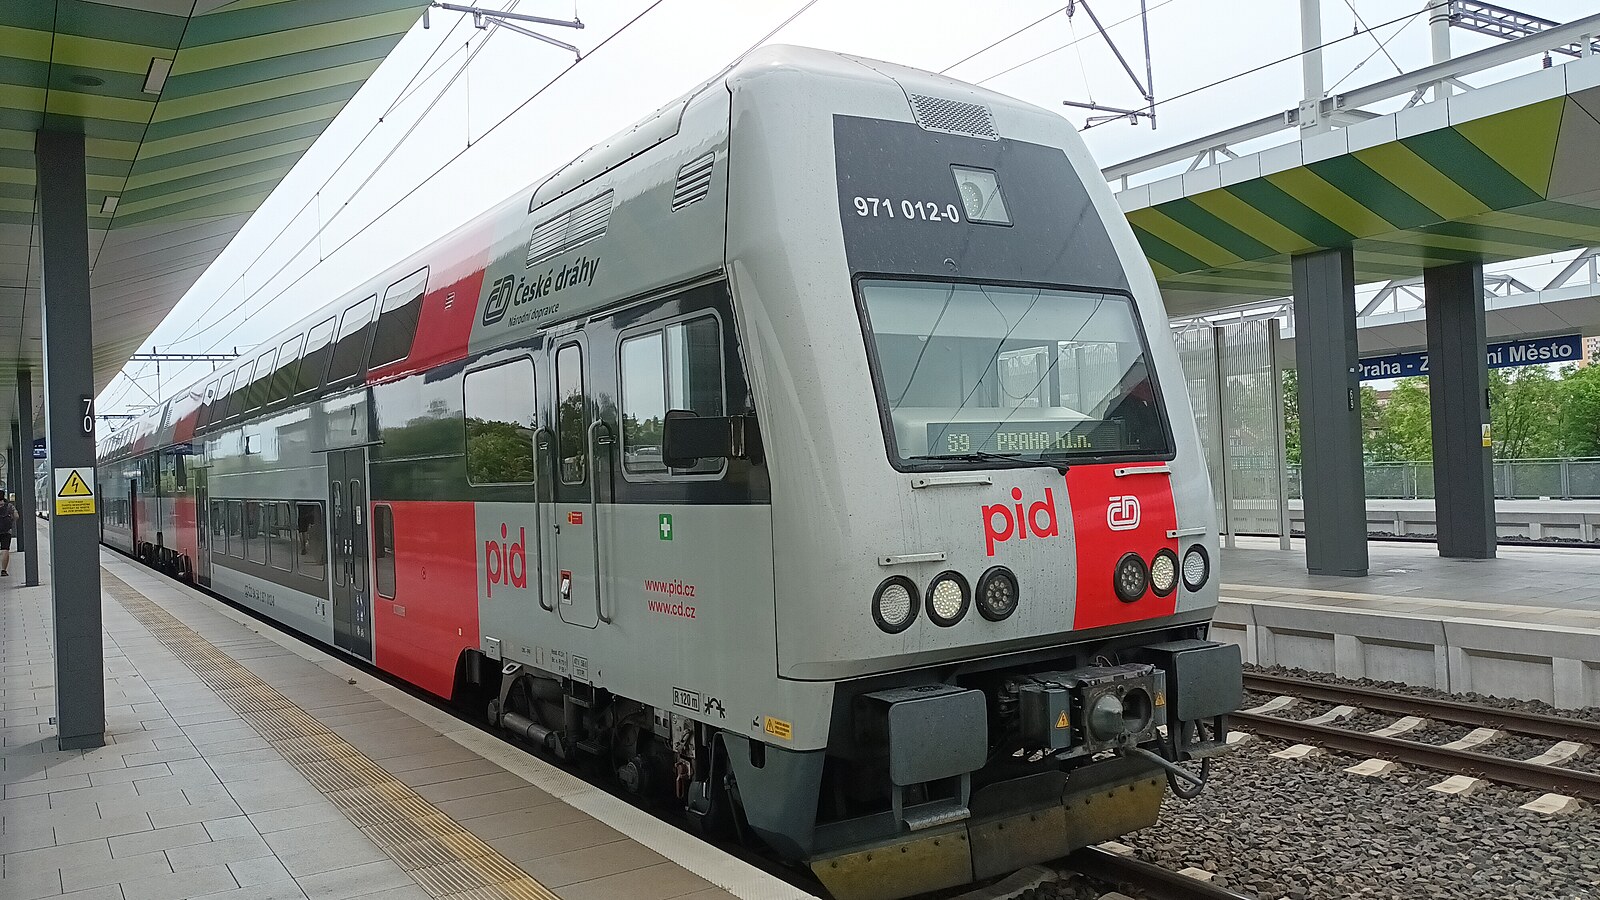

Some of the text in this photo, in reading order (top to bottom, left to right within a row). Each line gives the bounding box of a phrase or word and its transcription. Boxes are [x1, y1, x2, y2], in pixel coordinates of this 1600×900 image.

[853, 196, 960, 223] 971 012-0
[513, 256, 600, 307] České dráhy
[531, 303, 560, 321] dopravce
[1509, 343, 1573, 363] Město
[350, 404, 357, 436] 2
[947, 433, 970, 452] S9
[996, 431, 1050, 451] PRAHA
[981, 486, 1059, 557] pid
[485, 522, 527, 598] pid
[644, 578, 695, 598] www.pid.cz
[647, 600, 696, 619] www.cd.cz
[674, 690, 698, 709] R 120 m
